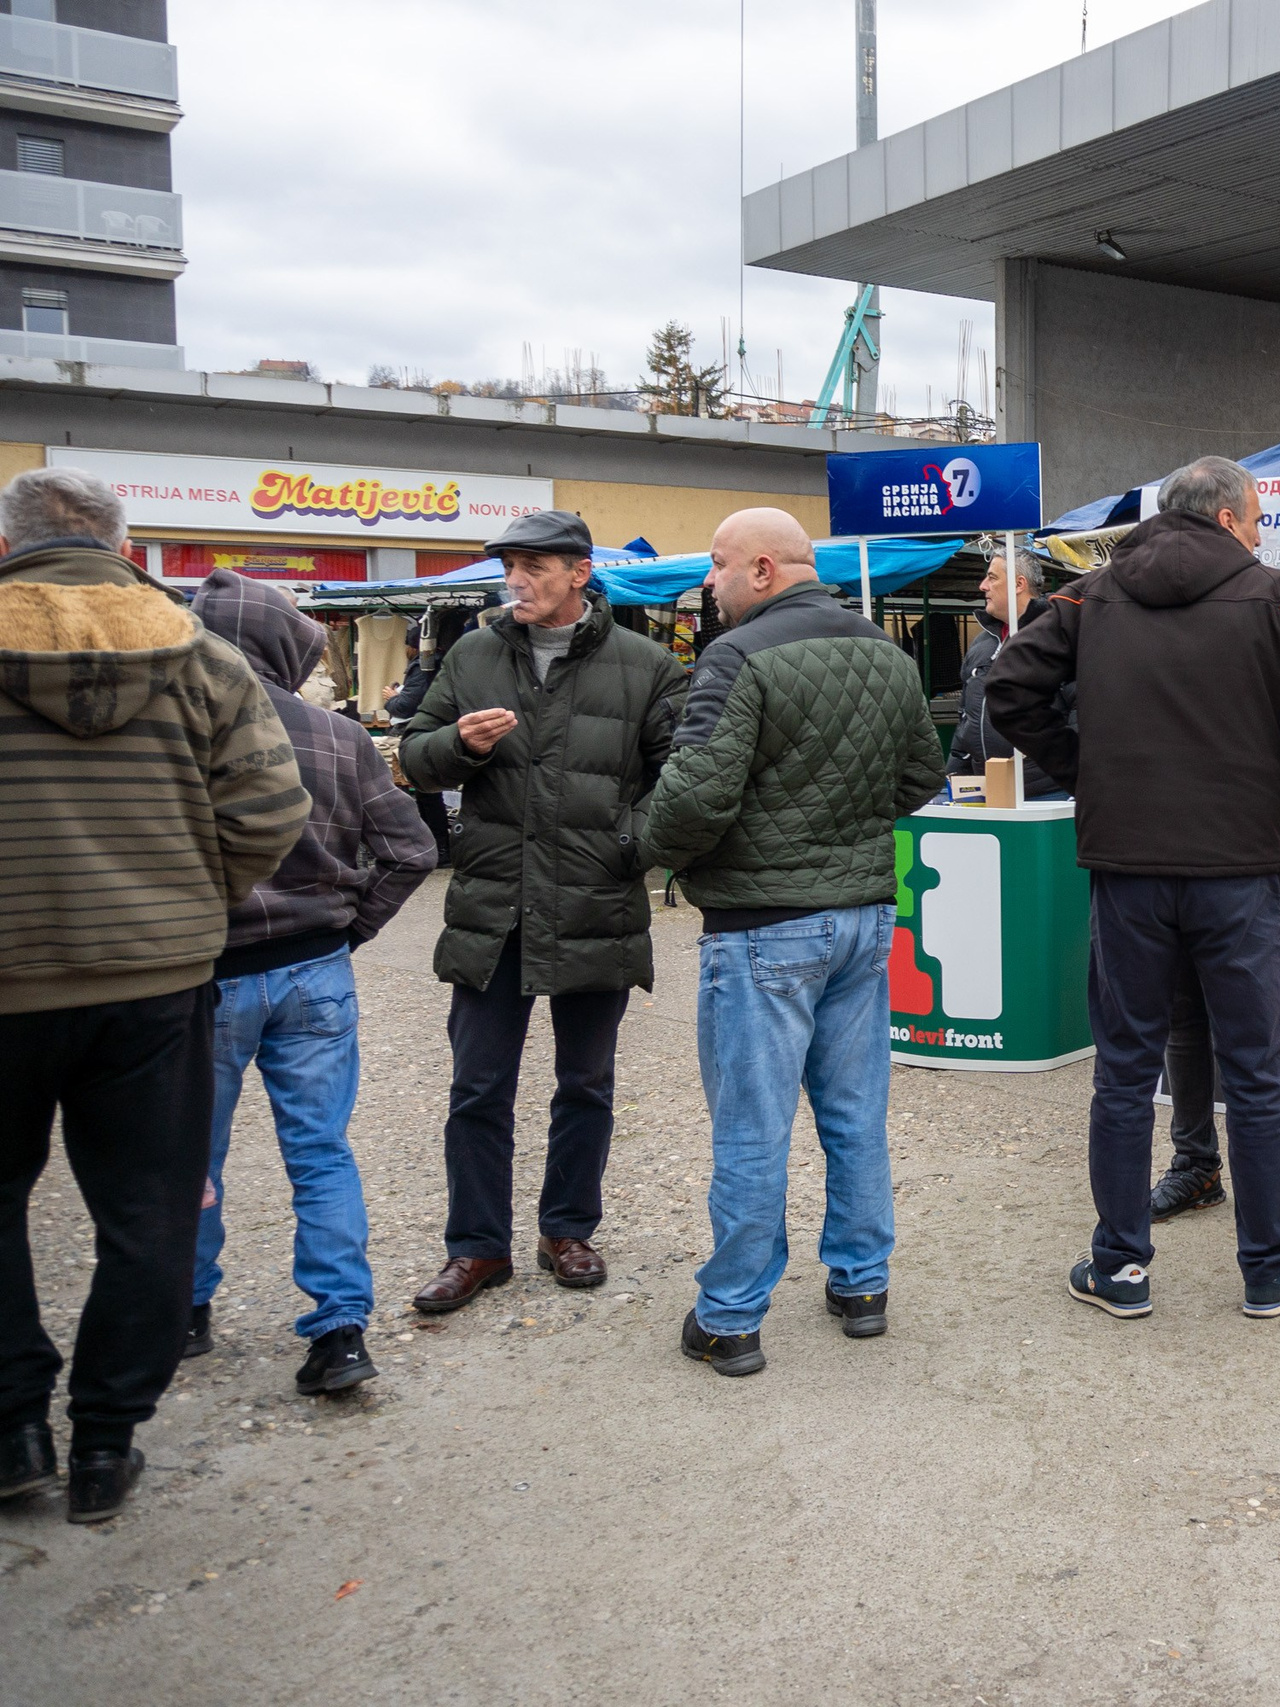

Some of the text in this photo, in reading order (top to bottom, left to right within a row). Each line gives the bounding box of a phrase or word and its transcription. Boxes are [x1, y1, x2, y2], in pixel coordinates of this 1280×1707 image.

[111, 483, 241, 503] STRIJA MESA
[250, 469, 460, 524] Matijević
[882, 483, 939, 496] СРБИЈА
[882, 494, 939, 507] ПРОТИВ
[469, 503, 506, 517] NOVI
[883, 505, 942, 517] НАСИЉА
[890, 1024, 1003, 1050] nolevifront
